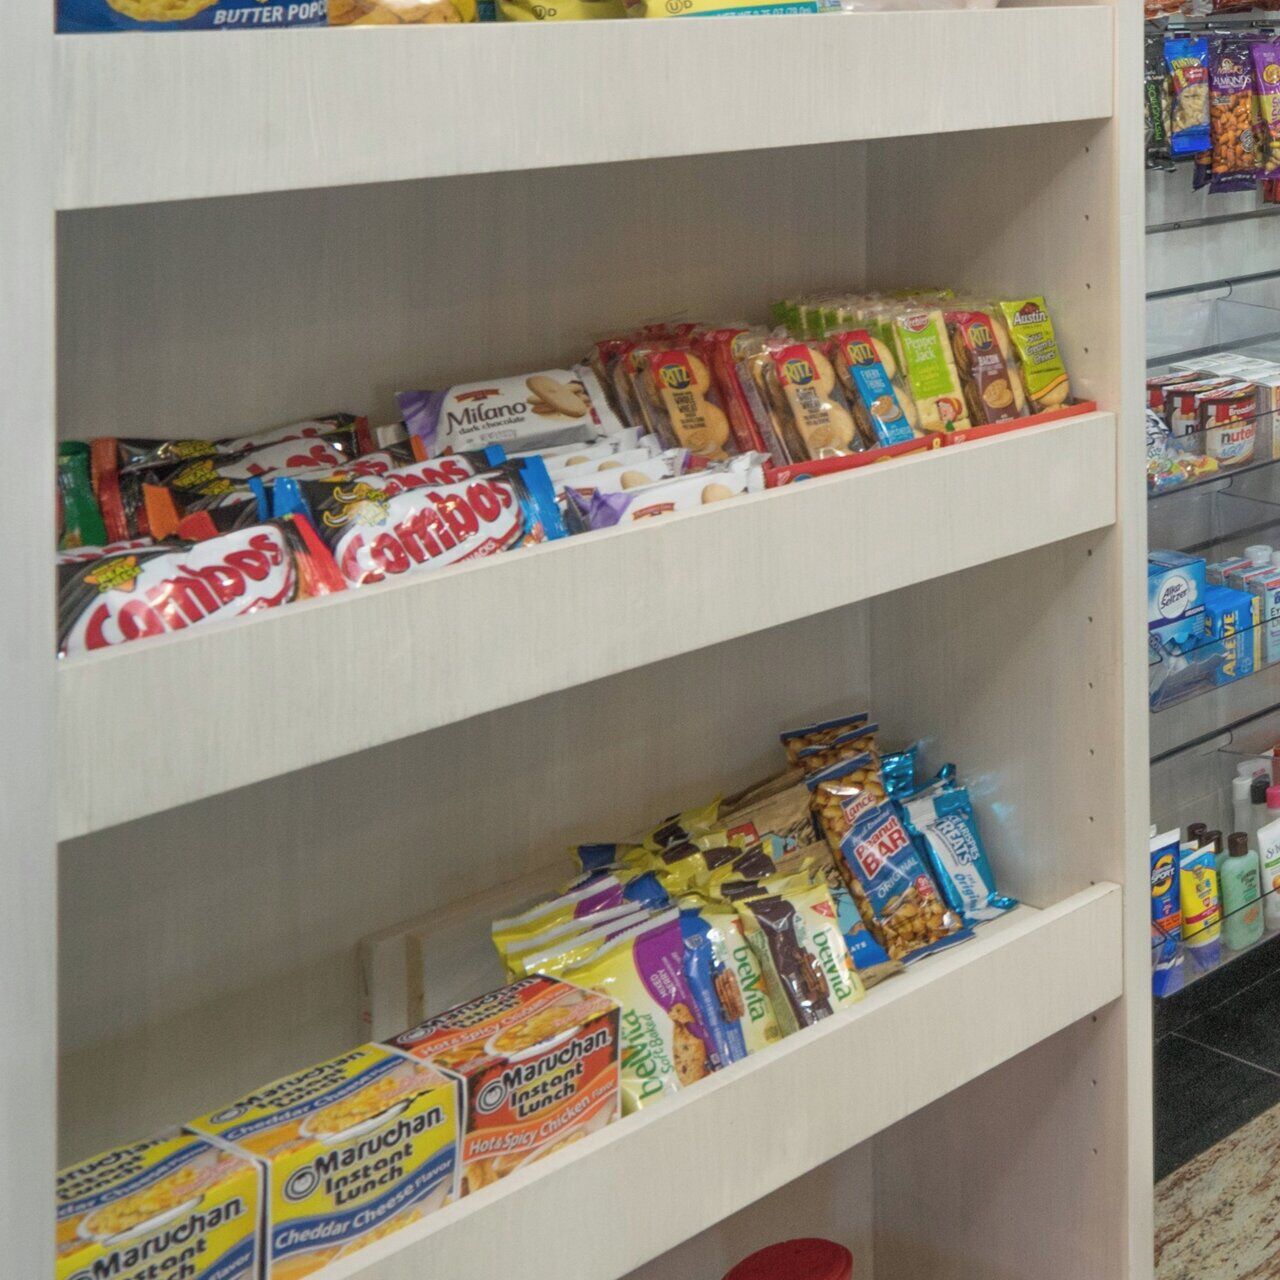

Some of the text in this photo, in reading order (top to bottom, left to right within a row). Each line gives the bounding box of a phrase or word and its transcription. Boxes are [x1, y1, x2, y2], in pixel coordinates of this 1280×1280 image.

[214, 6, 282, 25] BUTTER
[1213, 75, 1252, 86] ALMONDS
[1014, 311, 1046, 325] Austin
[905, 336, 937, 352] Pepper
[447, 401, 527, 435] Milano
[1223, 610, 1237, 676] ALEVE
[844, 792, 877, 823] Lance
[855, 815, 898, 859] Peanut
[861, 828, 908, 879] BAR
[502, 1029, 608, 1089] Maruchan
[511, 1062, 583, 1106] Instant
[518, 1082, 575, 1117] Lunch
[314, 1107, 442, 1174] Maruchan
[325, 1143, 413, 1194] Instant
[335, 1166, 403, 1205] Lunch
[275, 1222, 350, 1249] Cheddar
[353, 1183, 416, 1227] Cheese
[92, 1198, 242, 1279] Maruchan
